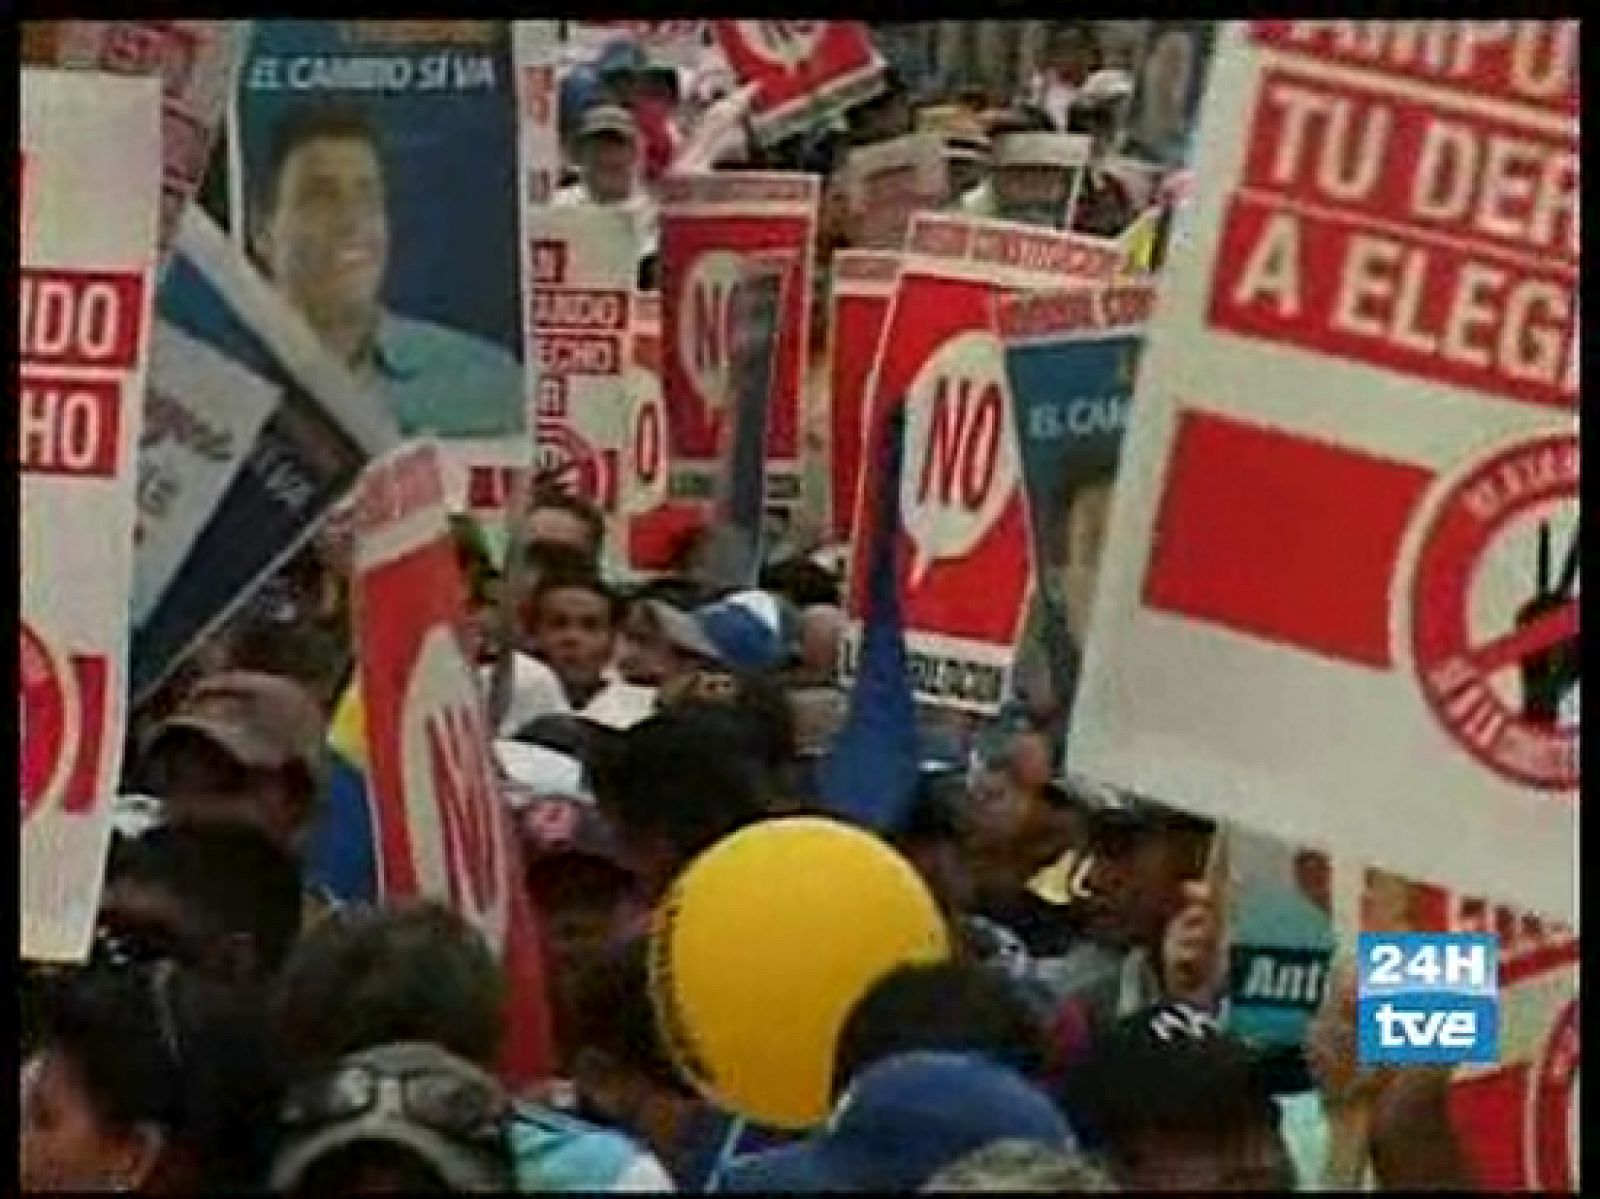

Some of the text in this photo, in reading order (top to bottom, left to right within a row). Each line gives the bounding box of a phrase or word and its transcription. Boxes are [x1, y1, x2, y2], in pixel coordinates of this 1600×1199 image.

[250, 57, 284, 88] EL
[454, 55, 496, 88] VA
[1268, 84, 1392, 199] TU
[1233, 213, 1301, 317] A
[914, 368, 1005, 512] NO
